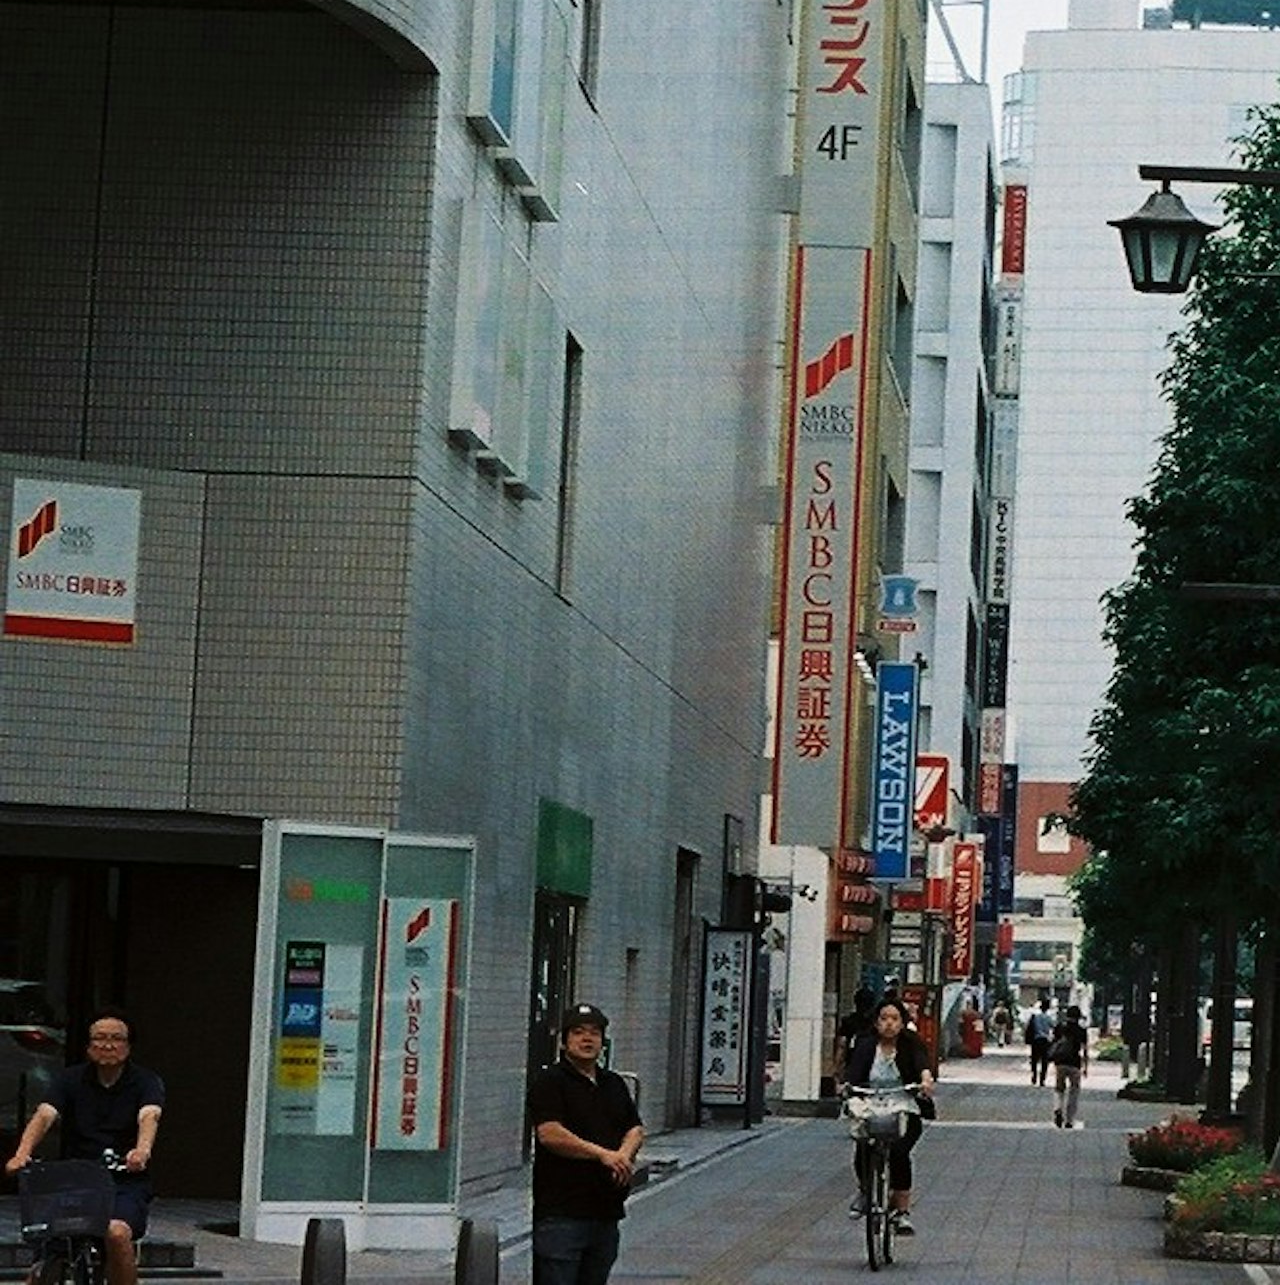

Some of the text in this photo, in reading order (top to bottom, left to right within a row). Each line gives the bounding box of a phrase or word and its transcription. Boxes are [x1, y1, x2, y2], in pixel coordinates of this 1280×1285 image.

[816, 125, 862, 161] 4F
[800, 421, 854, 434] NIKKO
[801, 405, 854, 421] SMBC
[16, 571, 128, 598] SMBC日興証券
[795, 460, 839, 760] SMBC日興証券
[878, 690, 910, 854] LAWSON
